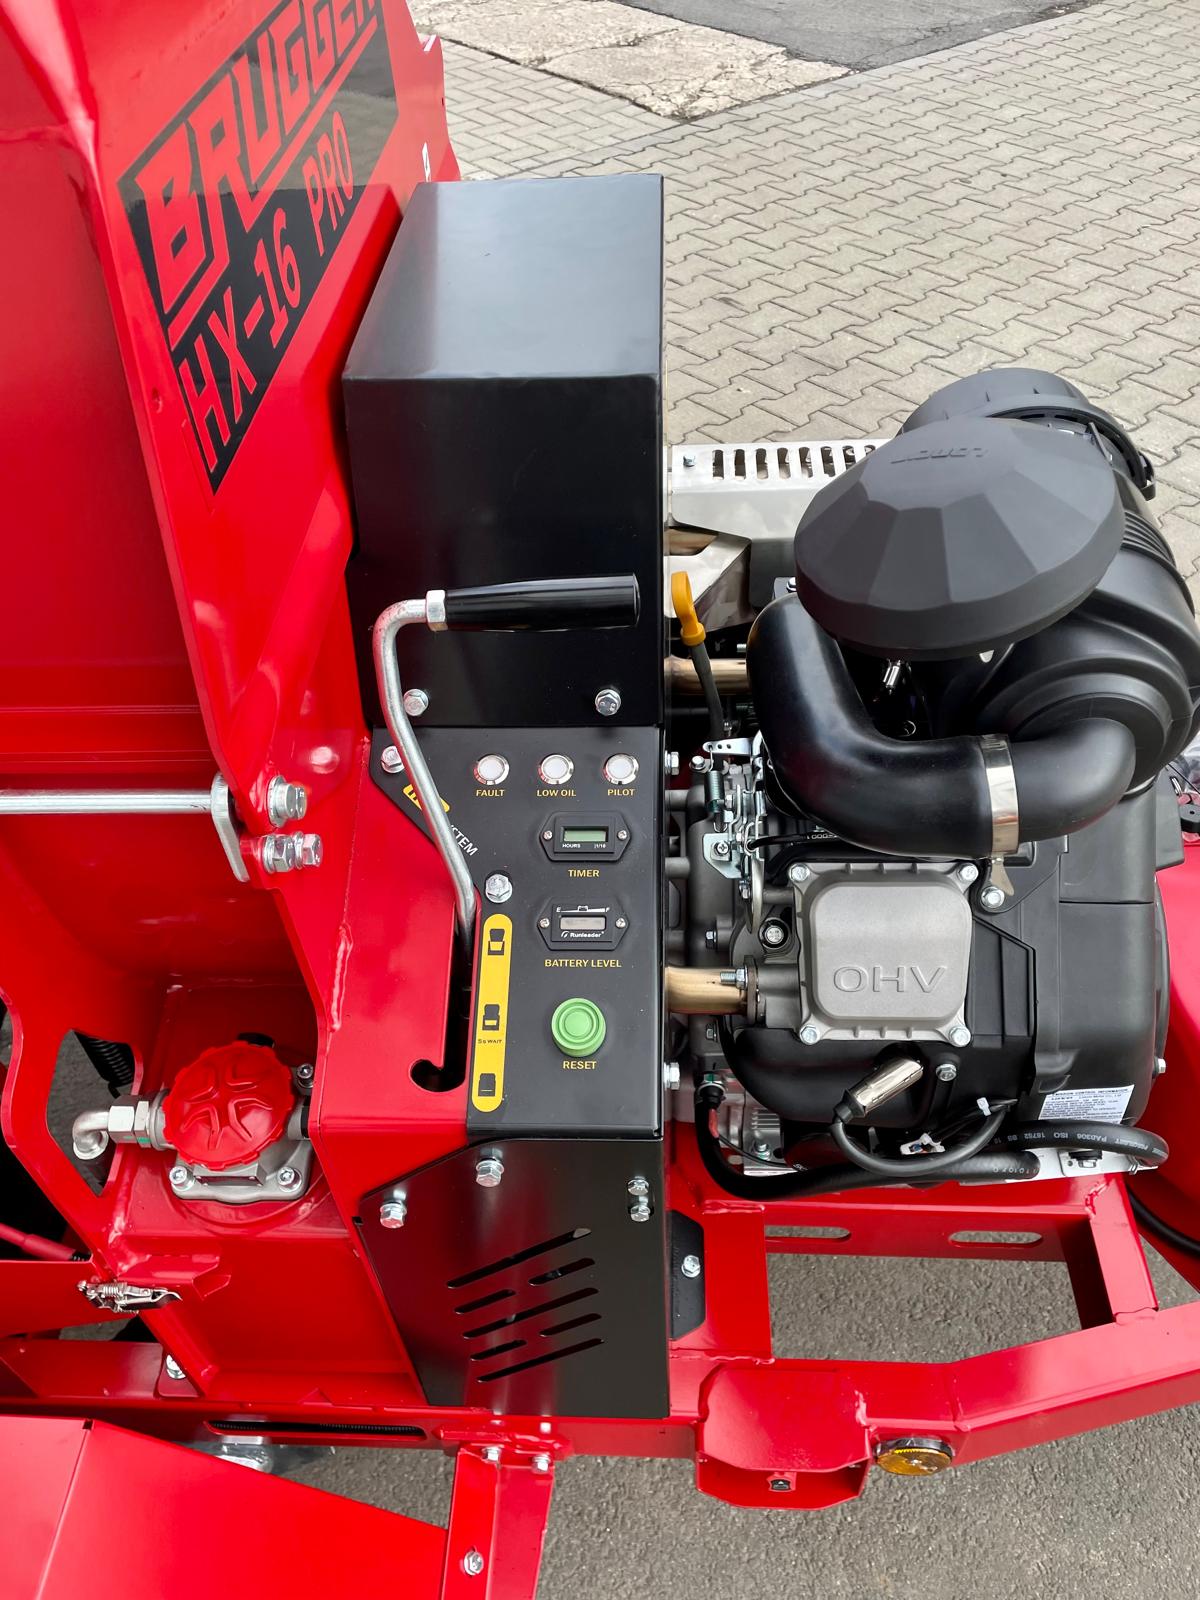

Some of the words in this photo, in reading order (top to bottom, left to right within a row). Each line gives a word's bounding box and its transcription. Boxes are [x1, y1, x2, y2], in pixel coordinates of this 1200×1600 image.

[135, 0, 377, 314] BRUGGE
[178, 207, 301, 473] HX-16
[302, 110, 355, 257] PRO
[476, 789, 505, 797] FAULT
[536, 789, 556, 797] LOW
[557, 789, 577, 797] OIL
[607, 788, 636, 797] PILOT
[568, 869, 600, 878] TIMER
[544, 959, 589, 968] BATTERY
[591, 959, 622, 968] LEVEL
[833, 966, 947, 993] OHV
[563, 1061, 597, 1070] RESET
